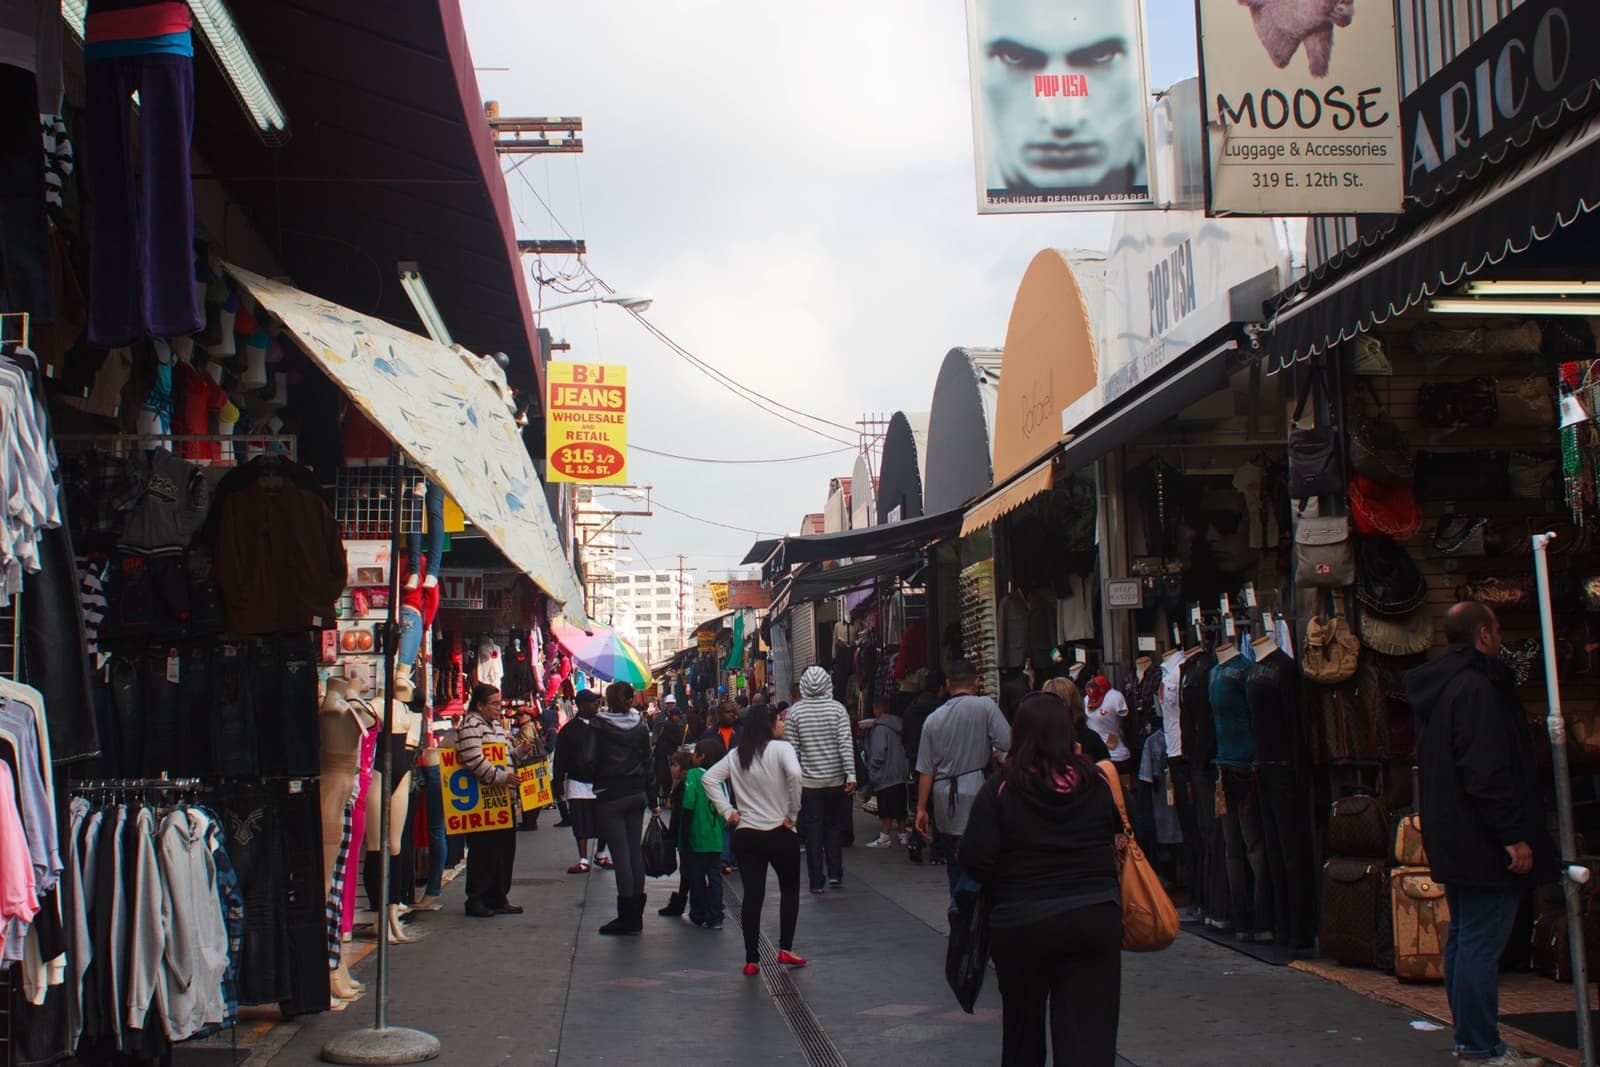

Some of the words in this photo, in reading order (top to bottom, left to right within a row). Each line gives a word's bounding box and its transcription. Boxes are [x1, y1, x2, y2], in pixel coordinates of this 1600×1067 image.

[1062, 74, 1088, 97] USA
[1408, 7, 1571, 188] ARICO
[1216, 85, 1389, 131] MOOSE
[1225, 143, 1285, 160] Luggage
[1290, 143, 1300, 157] &
[1305, 142, 1387, 157] Accessories
[1252, 172, 1279, 188] 319
[1285, 172, 1299, 188] E.
[1306, 172, 1338, 188] 12th
[1343, 172, 1364, 188] St.
[986, 195, 1043, 204] EXCLUSIVE
[1047, 194, 1100, 203] DESIGNED
[1148, 259, 1170, 338] POP
[1171, 238, 1197, 323] USA
[553, 386, 623, 409] JEANS
[552, 412, 625, 424] WHOLESALE
[566, 431, 610, 442] RETAIL
[561, 448, 595, 464] 315
[597, 454, 616, 464] 1/2
[565, 465, 575, 473] E.
[596, 466, 611, 475] ST.
[437, 575, 482, 599] ATM
[441, 746, 504, 767] WEN
[482, 796, 508, 810] JEANS
[448, 810, 509, 831] GIRLS
